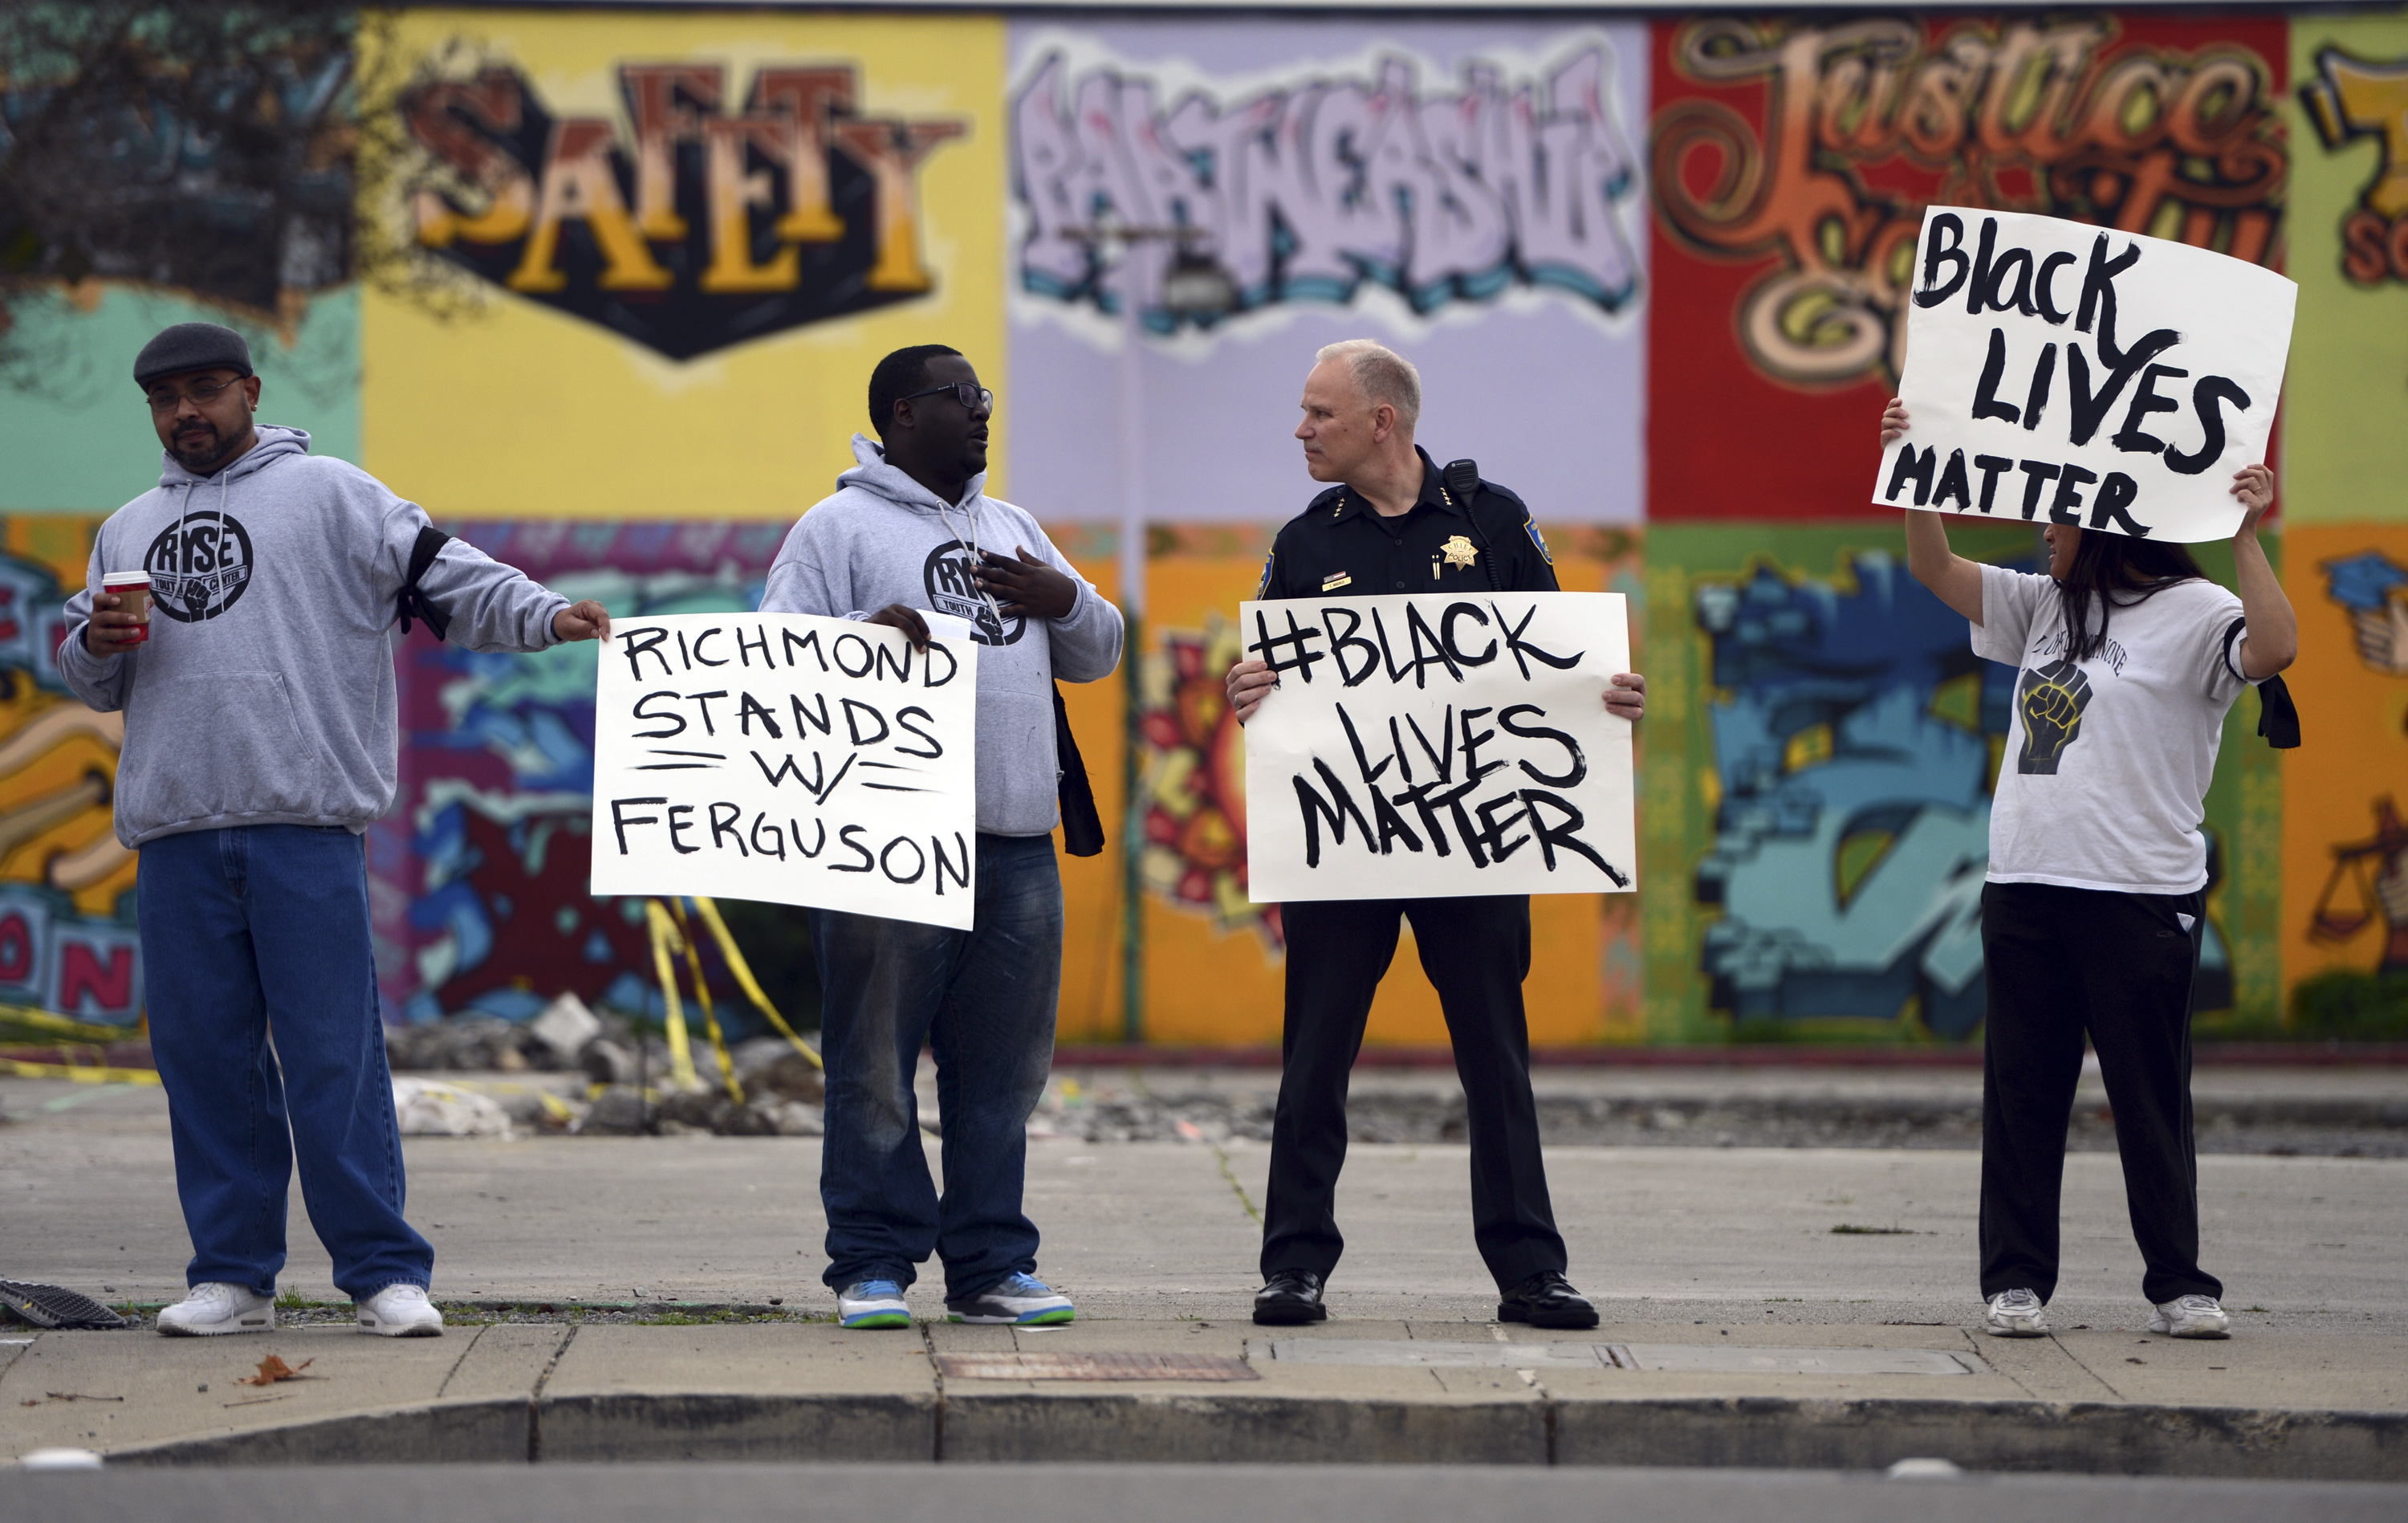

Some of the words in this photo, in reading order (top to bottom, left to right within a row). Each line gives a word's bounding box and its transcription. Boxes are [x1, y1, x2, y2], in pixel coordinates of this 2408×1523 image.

[403, 63, 970, 294] SAFETY
[1972, 328, 2251, 475] LIVES
[1885, 442, 2153, 538] MATTER
[157, 525, 236, 574] RYSE
[1448, 543, 1474, 551] CHIEF
[1448, 552, 1472, 562] POLICE
[943, 599, 974, 617] YOUTH
[1248, 601, 1586, 689] #BLACK
[616, 624, 958, 687] RICHMOND
[632, 690, 943, 759] STANDS
[1336, 702, 1587, 788] LIVES
[610, 796, 970, 895] FERGUSON
[1292, 756, 1631, 889] MATTER
